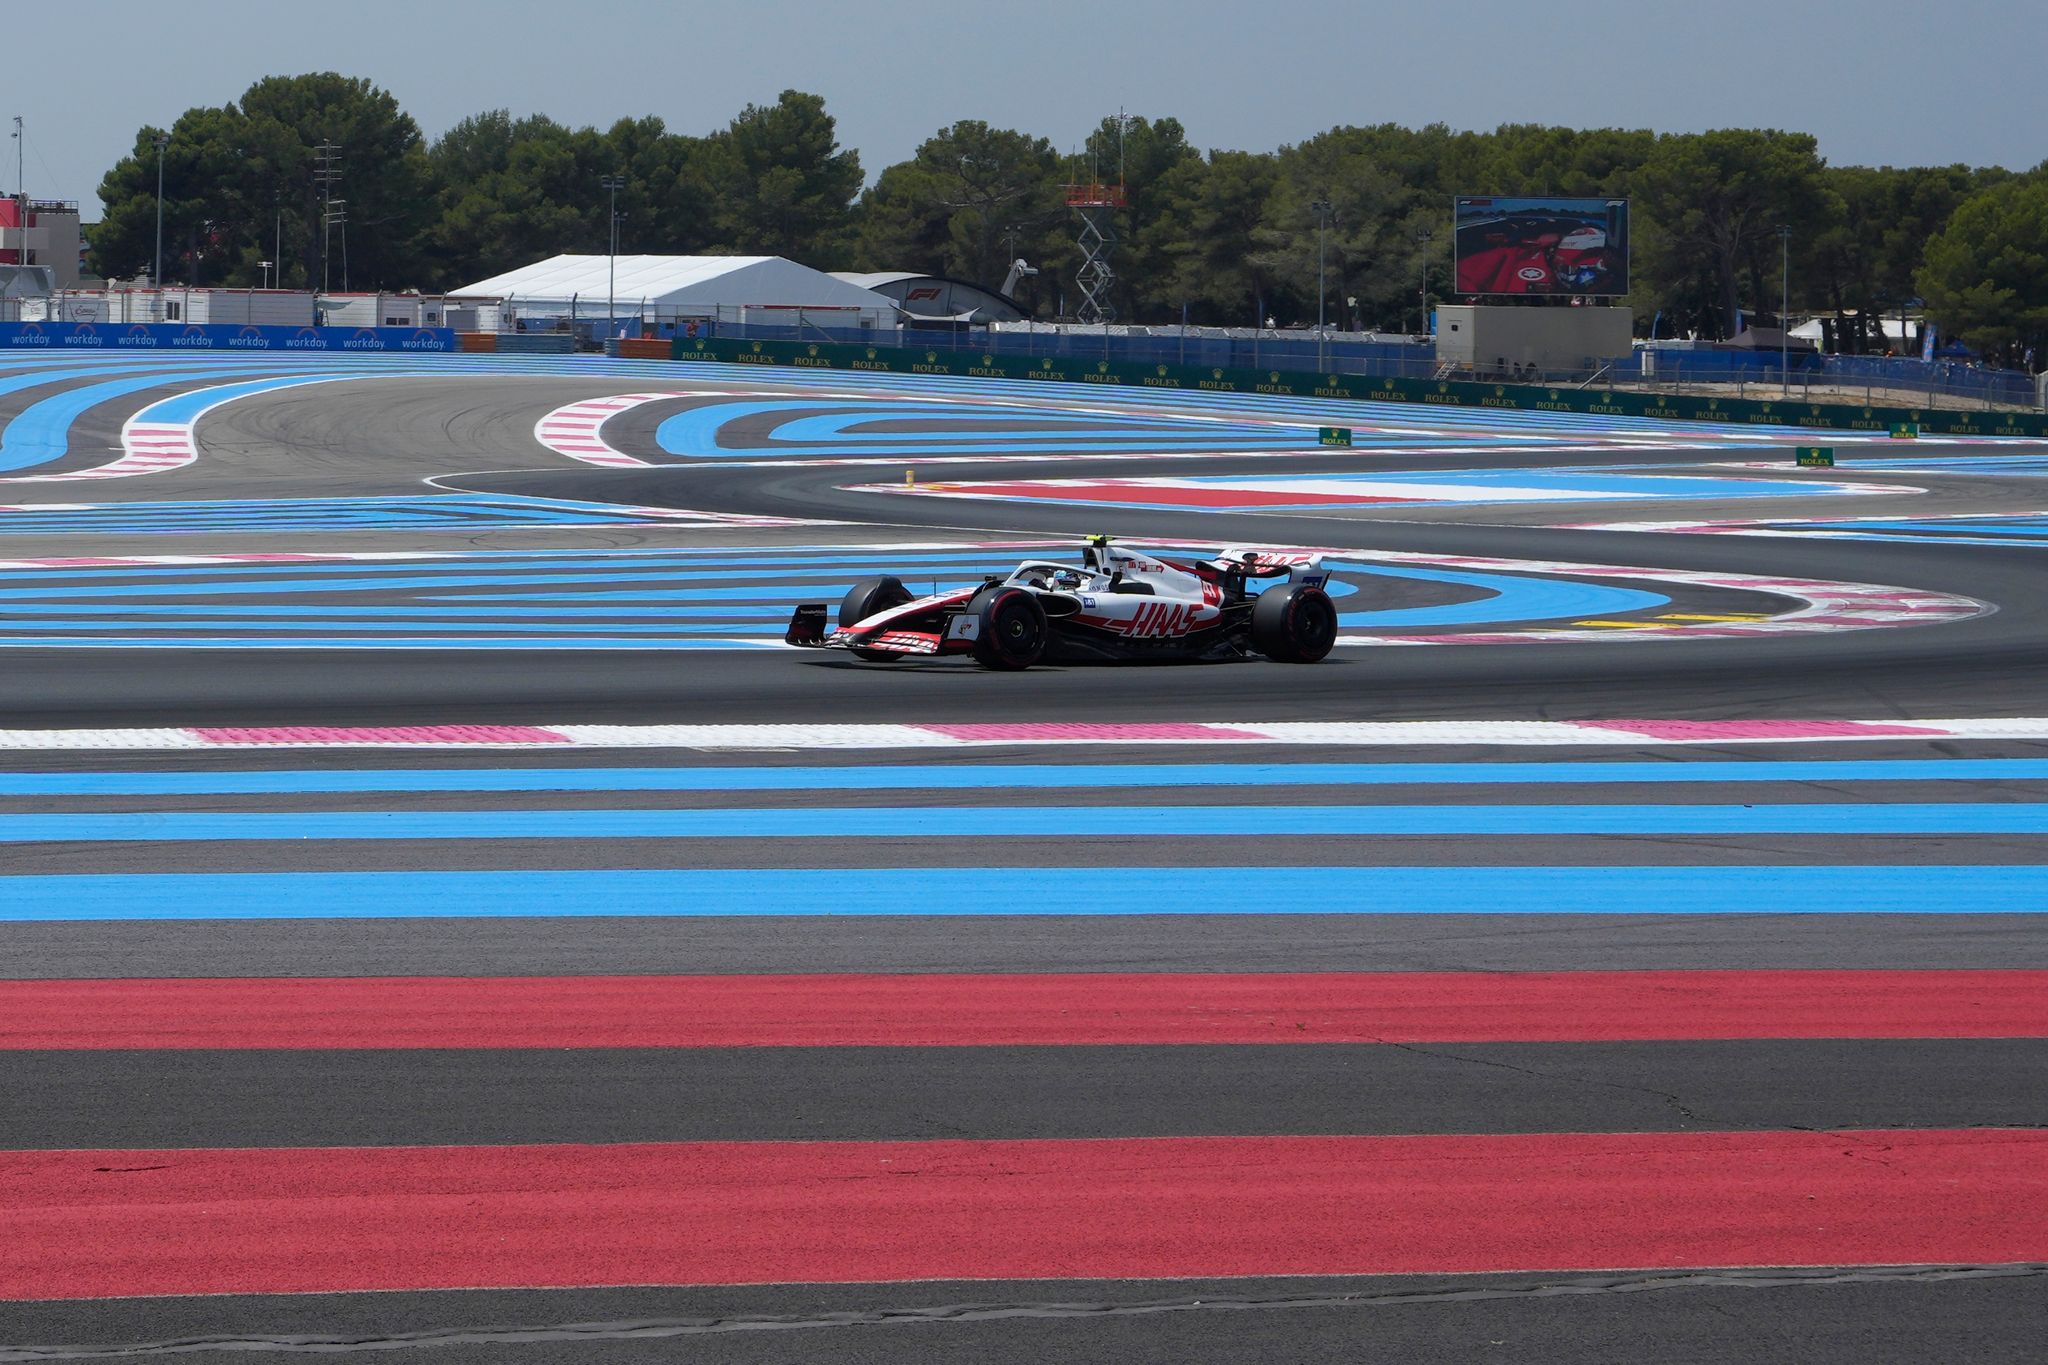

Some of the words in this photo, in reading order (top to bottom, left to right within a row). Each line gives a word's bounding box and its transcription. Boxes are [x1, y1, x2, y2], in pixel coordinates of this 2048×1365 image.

[908, 289, 941, 300] F1
[682, 352, 717, 360] ROLEX
[739, 354, 774, 364] ROLEX
[795, 357, 831, 367] ROLEX
[853, 361, 889, 370] ROLEX
[912, 364, 948, 373] ROLEX
[969, 368, 1005, 377] ROLEX
[1028, 371, 1064, 380] ROLEX
[1085, 374, 1120, 384] ROLEX
[1144, 378, 1179, 386] ROLEX
[1200, 381, 1234, 390] ROLEX
[1257, 384, 1292, 394] ROLEX
[1315, 388, 1350, 397] ROLEX
[1371, 392, 1406, 400] ROLEX
[1425, 394, 1459, 404] ROLEX
[1482, 398, 1516, 407] ROLEX
[1536, 402, 1571, 411] ROLEX
[1119, 602, 1204, 638] HAAS
